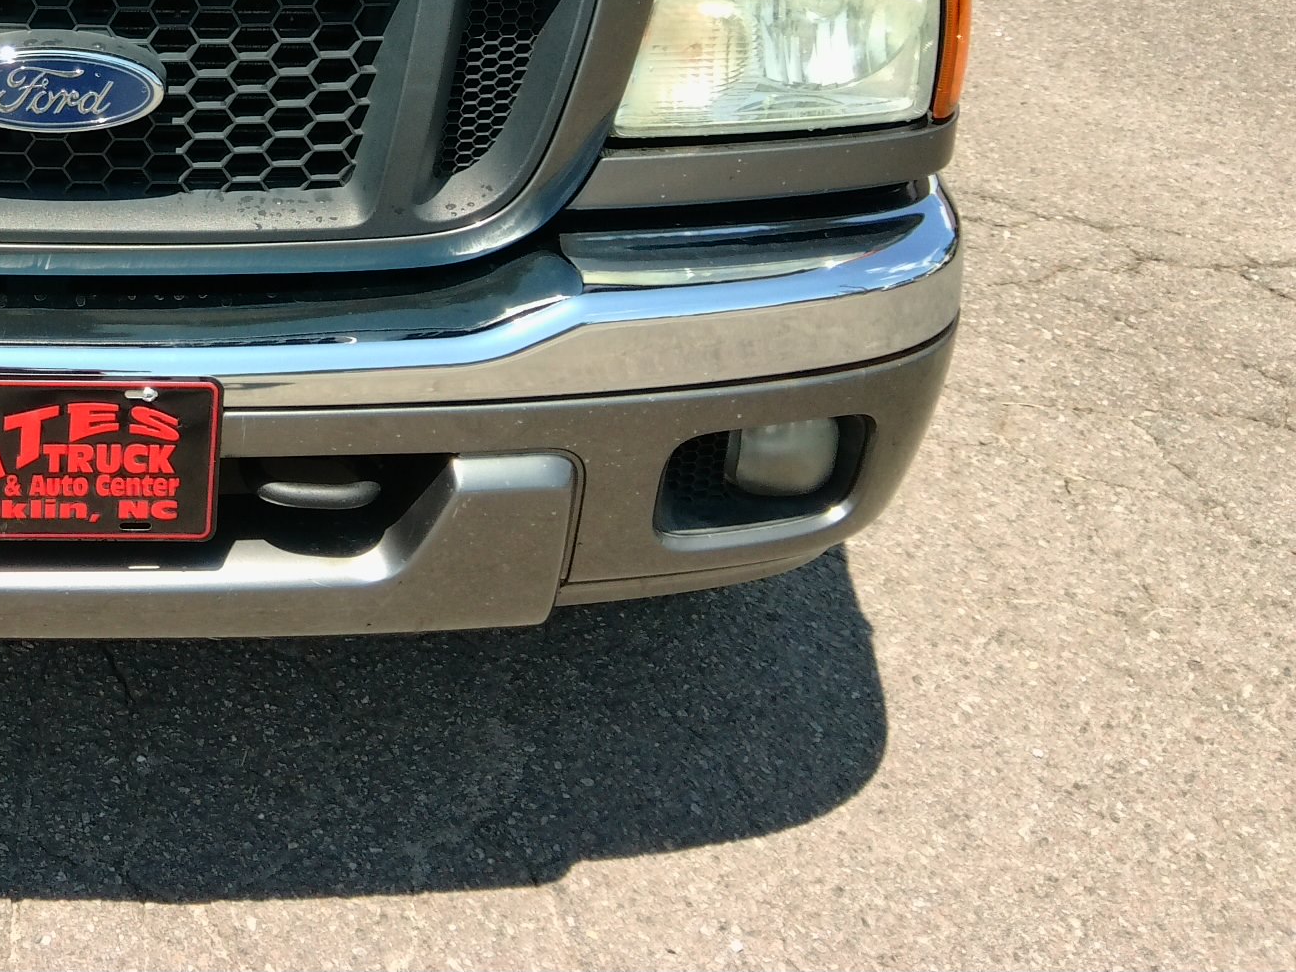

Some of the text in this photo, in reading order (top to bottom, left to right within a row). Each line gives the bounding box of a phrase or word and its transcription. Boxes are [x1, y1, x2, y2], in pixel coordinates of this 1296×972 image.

[42, 443, 176, 474] TRUCK
[4, 474, 181, 497] & Auto Center
[116, 500, 179, 520] NC
